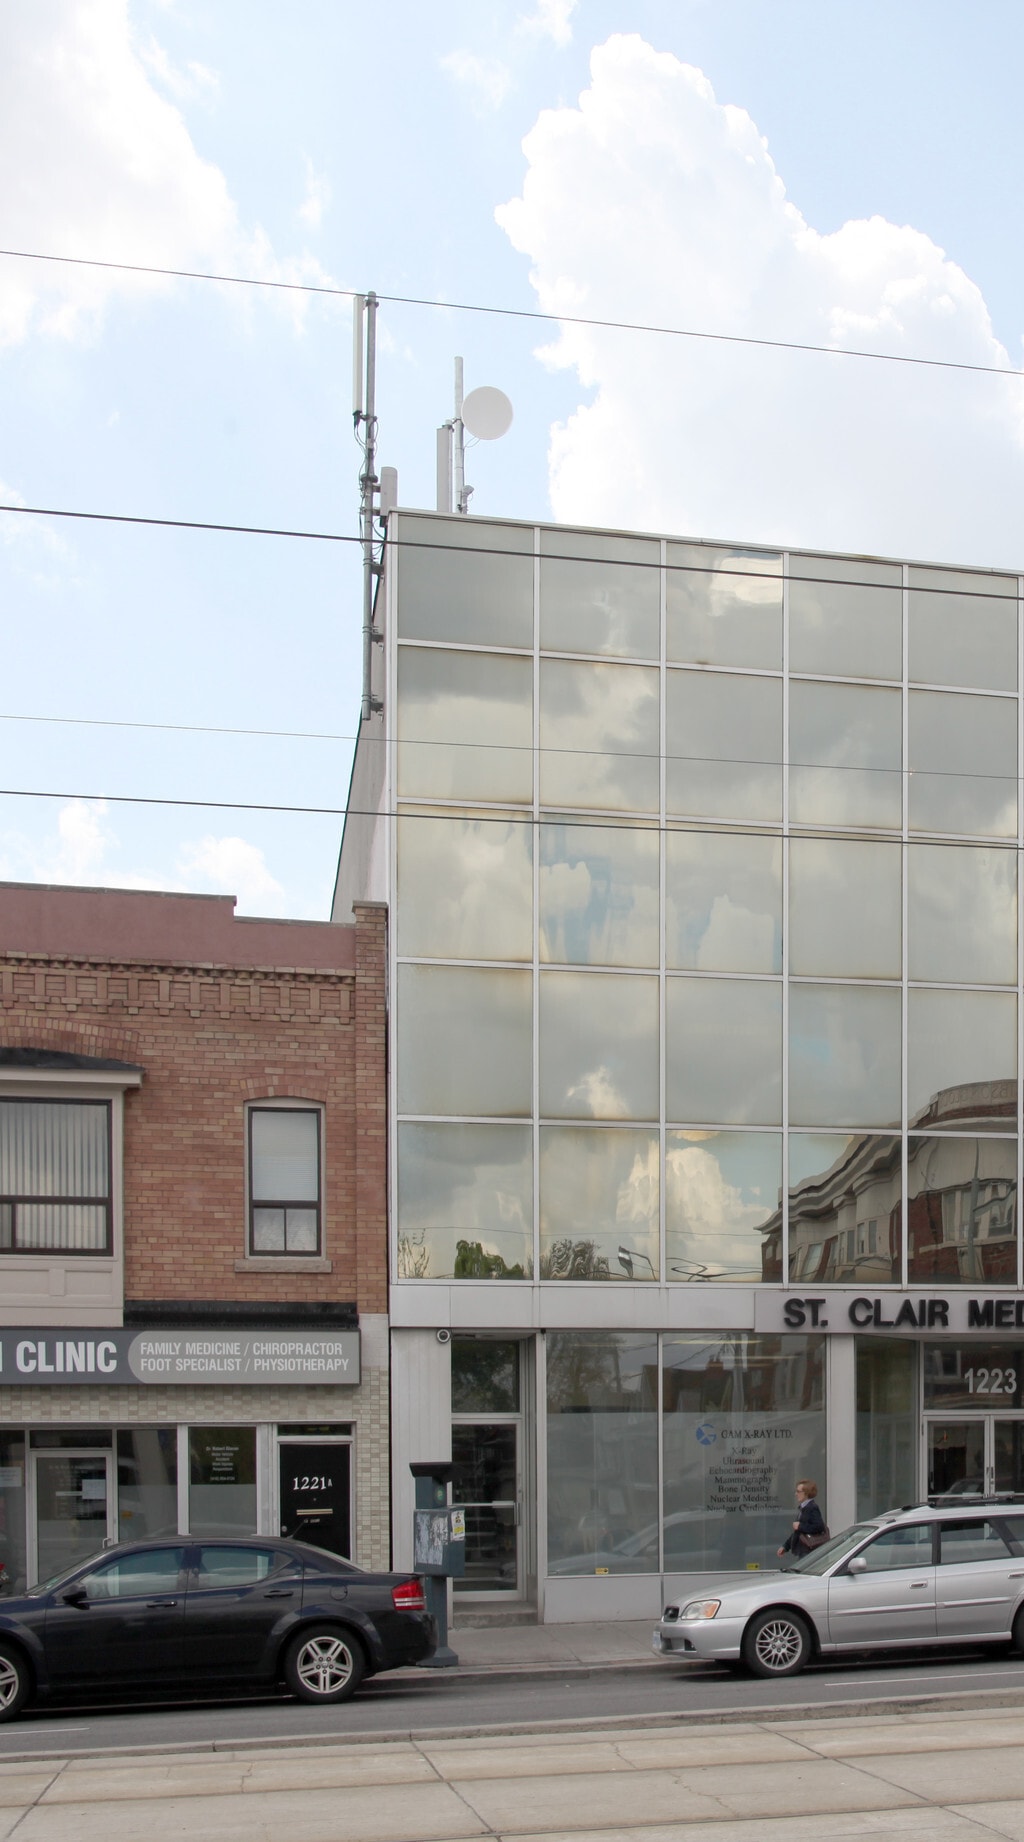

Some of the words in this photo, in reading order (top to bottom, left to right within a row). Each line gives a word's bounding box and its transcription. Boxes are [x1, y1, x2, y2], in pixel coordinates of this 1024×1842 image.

[784, 1298, 828, 1327] ST.
[848, 1298, 949, 1327] CLAIR
[140, 1342, 182, 1355] FAMILY
[186, 1342, 241, 1355] MEDICINE
[253, 1342, 343, 1355] CHIROPRACTOR
[16, 1341, 117, 1372] CLINIC
[140, 1358, 172, 1371] FOOT
[175, 1358, 242, 1371] SPECIALIST
[254, 1358, 349, 1371] PHYSIOTHERAPY
[964, 1368, 1017, 1393] 1223
[744, 1429, 773, 1439] X-RAY
[774, 1428, 793, 1439] LTD.
[731, 1447, 757, 1456] X-Ray
[722, 1456, 765, 1465] Ultrasound
[709, 1466, 778, 1476] Echocardiography
[714, 1476, 772, 1486] Mammography
[718, 1485, 738, 1493] Bone
[740, 1485, 770, 1494] Density
[710, 1494, 740, 1503] Nuclear
